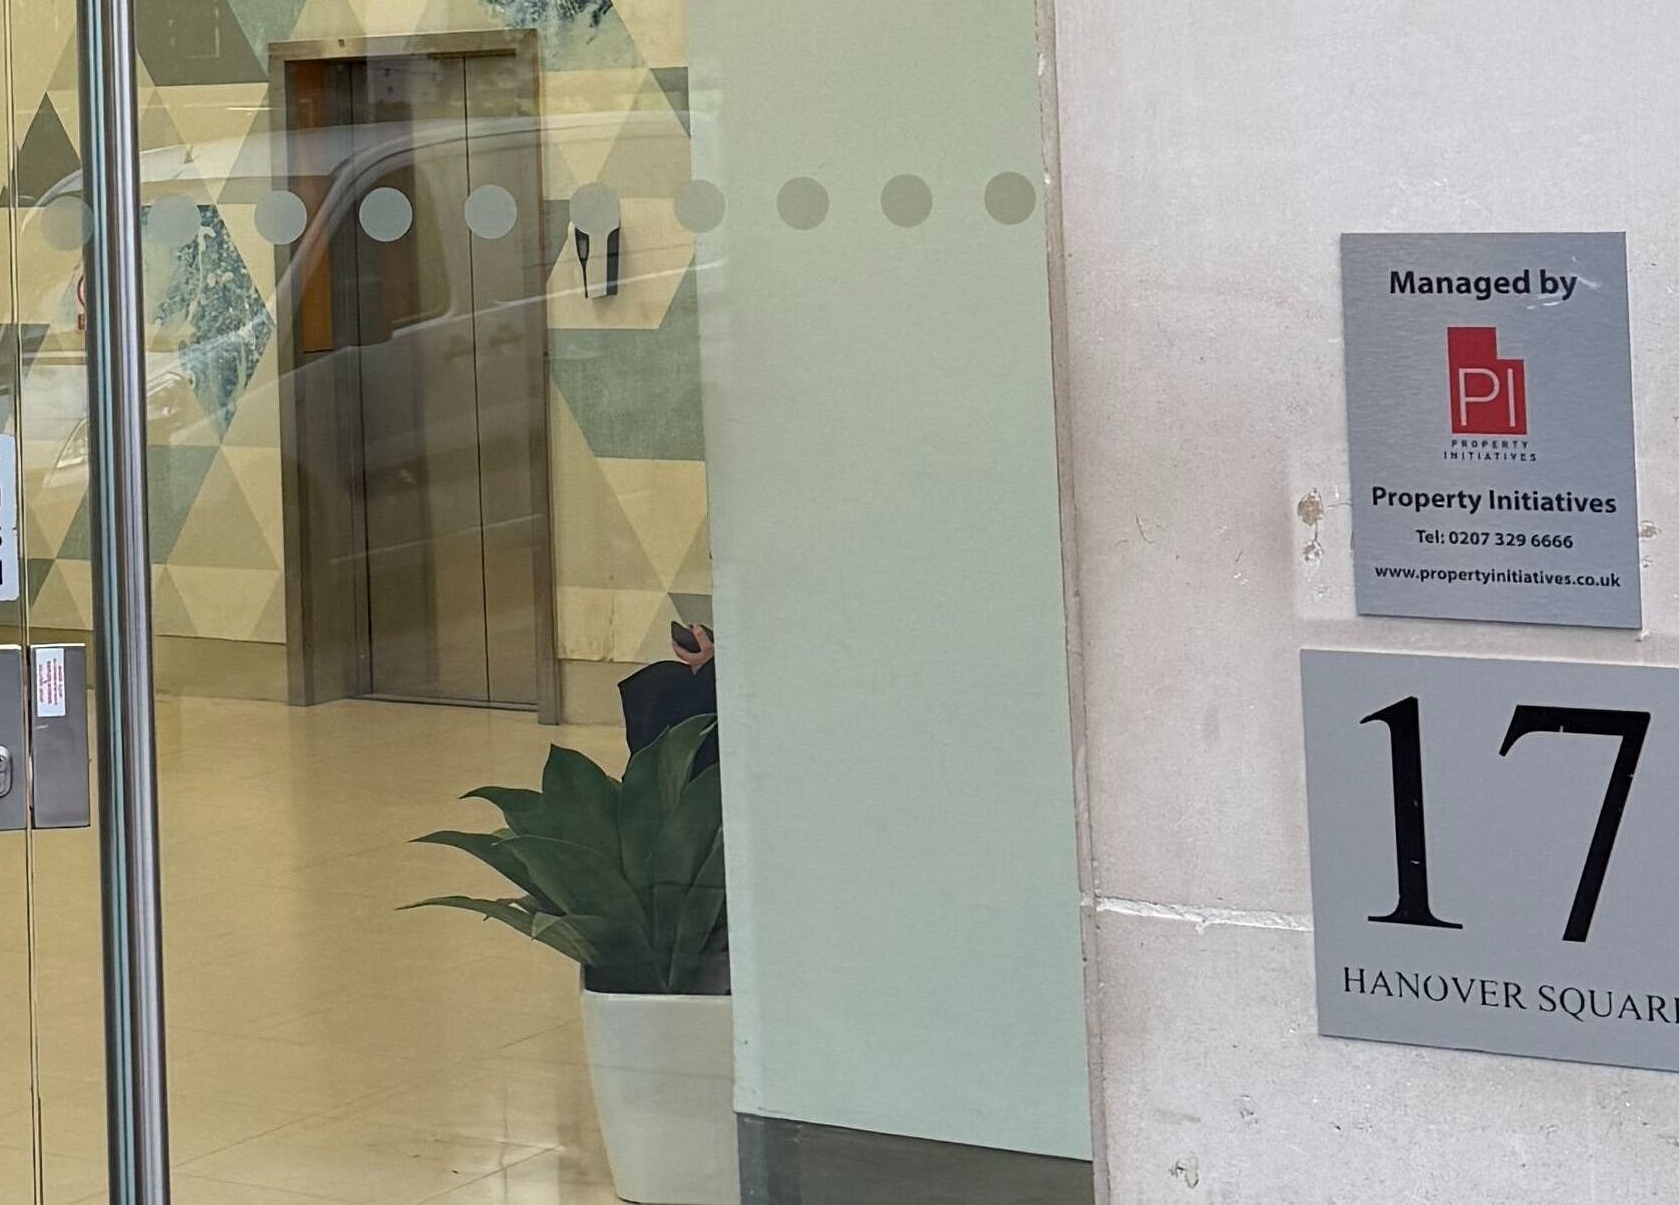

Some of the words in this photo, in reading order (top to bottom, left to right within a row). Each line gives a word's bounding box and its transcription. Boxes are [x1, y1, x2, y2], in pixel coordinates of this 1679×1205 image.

[1390, 269, 1531, 301] Managed
[1539, 269, 1577, 301] by
[1458, 367, 1517, 428] PI
[1443, 451, 1537, 462] INITIATIVES
[1451, 439, 1528, 449] PROPERTY
[1371, 486, 1482, 514] Property
[1488, 489, 1618, 514] Initiatives
[1416, 529, 1445, 545] Tel:
[1448, 531, 1489, 546] 0207
[1494, 532, 1527, 547] 329
[1530, 534, 1574, 549] 6666
[1374, 566, 1621, 588] www.propertyinitiatives.co.uk
[1358, 695, 1652, 943] 17
[1343, 966, 1528, 1010] HANOVER
[1537, 984, 1679, 1024] SQUAR
